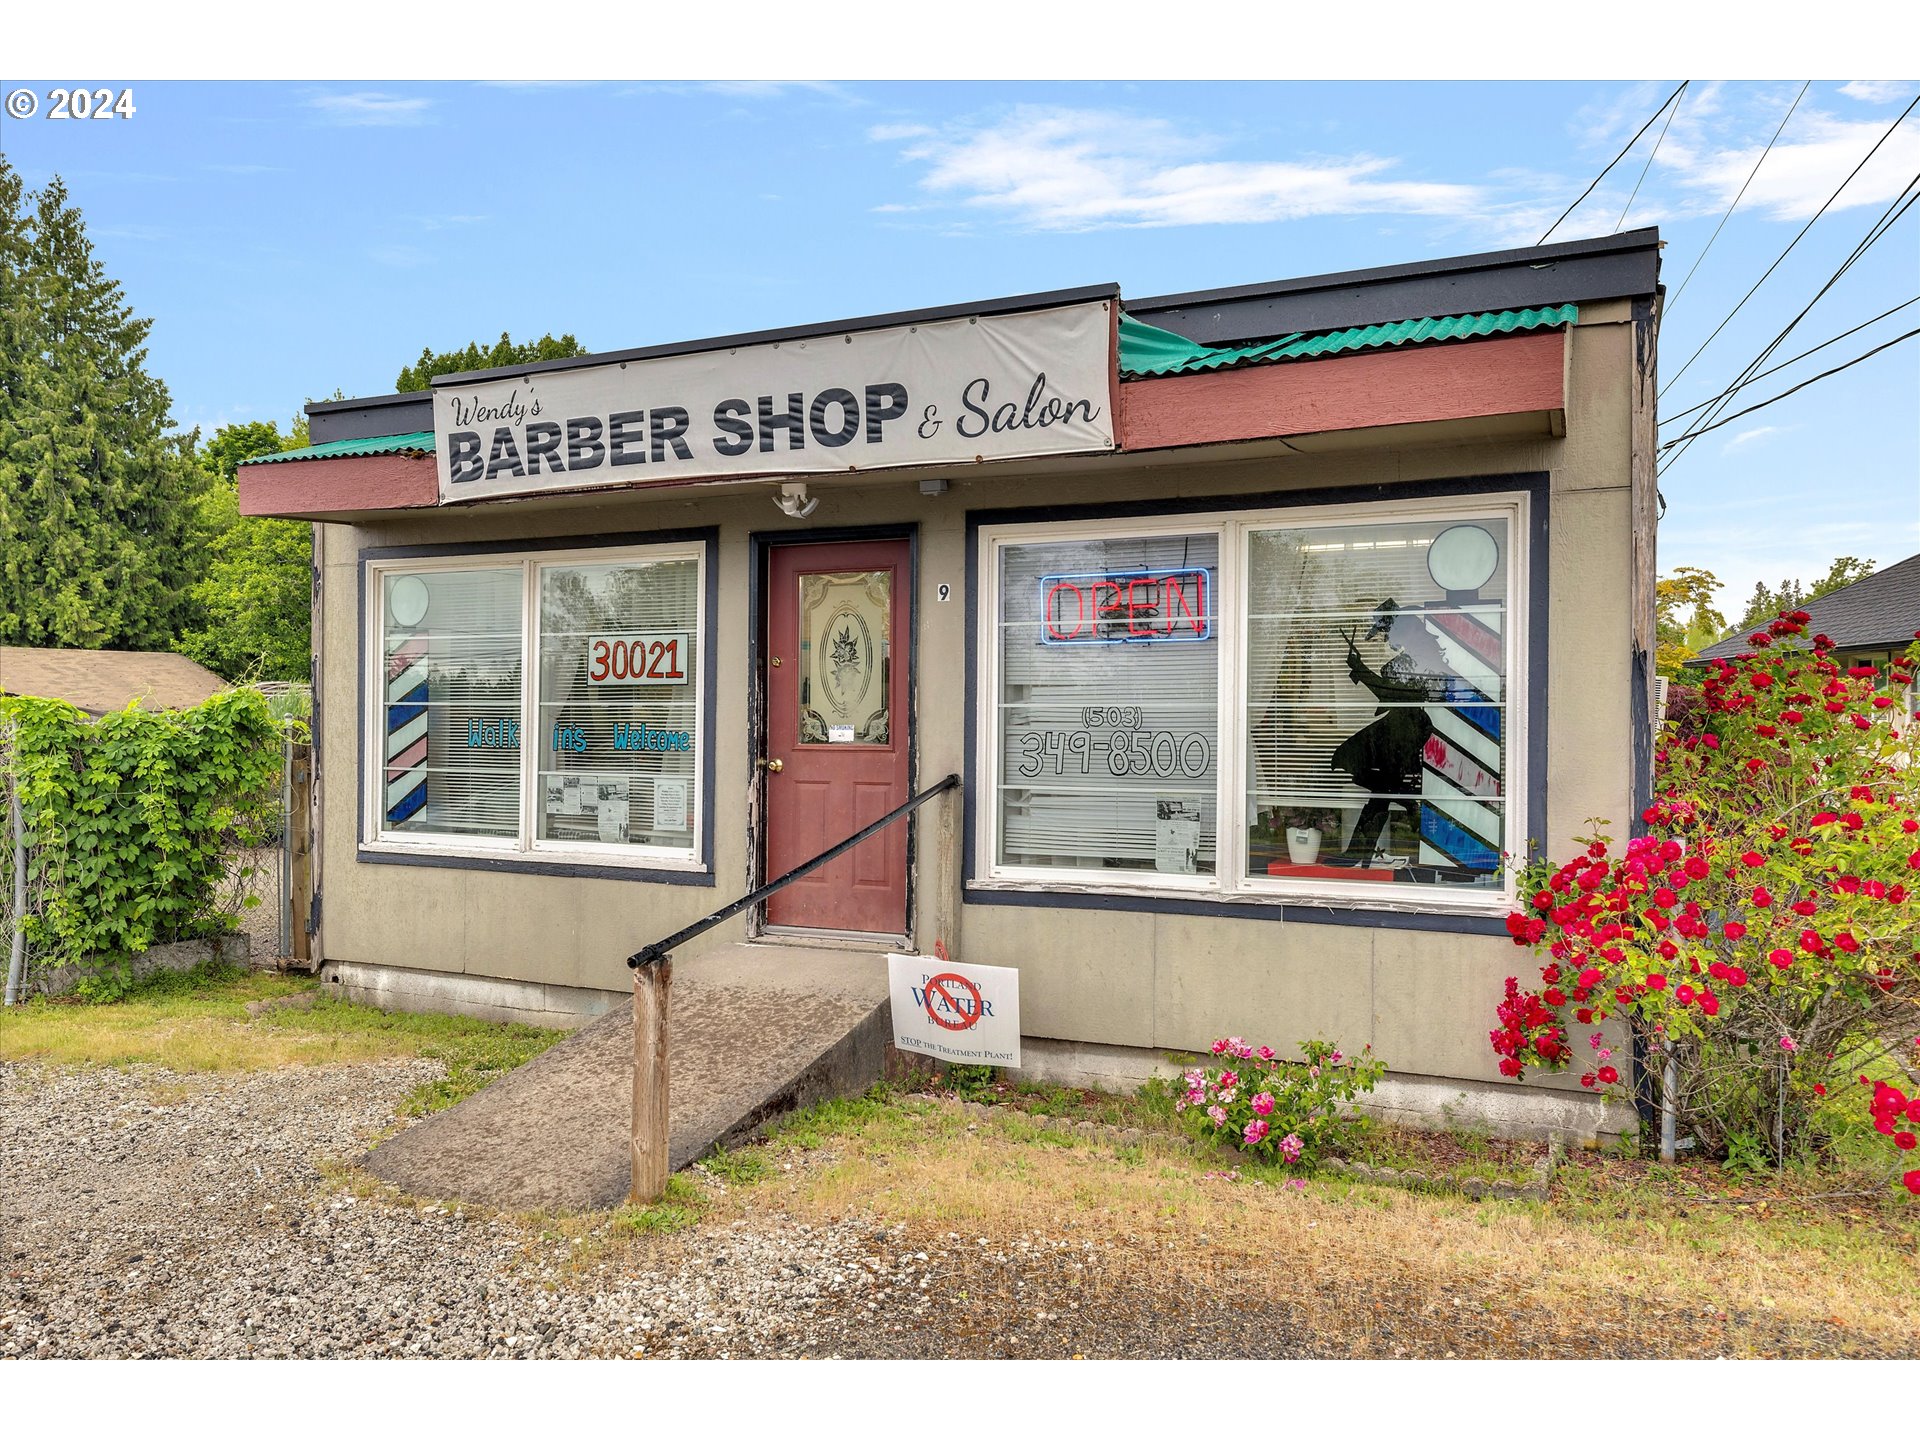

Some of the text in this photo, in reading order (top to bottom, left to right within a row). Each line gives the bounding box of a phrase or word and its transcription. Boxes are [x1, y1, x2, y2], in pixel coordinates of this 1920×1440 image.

[451, 387, 543, 427] Wendy's
[448, 372, 1101, 484] BARBER SHOP & Salon
[939, 584, 949, 601] 9
[1046, 574, 1203, 640] OPEN
[590, 639, 684, 682] 30021
[467, 718, 520, 749] Walk
[613, 722, 691, 751] Welcome
[1082, 706, 1143, 730] (503)
[1018, 729, 1211, 778] 349-8500
[911, 987, 995, 1017] WATER
[901, 1035, 1013, 1061] STOP THE TREATMENT PLANT!
